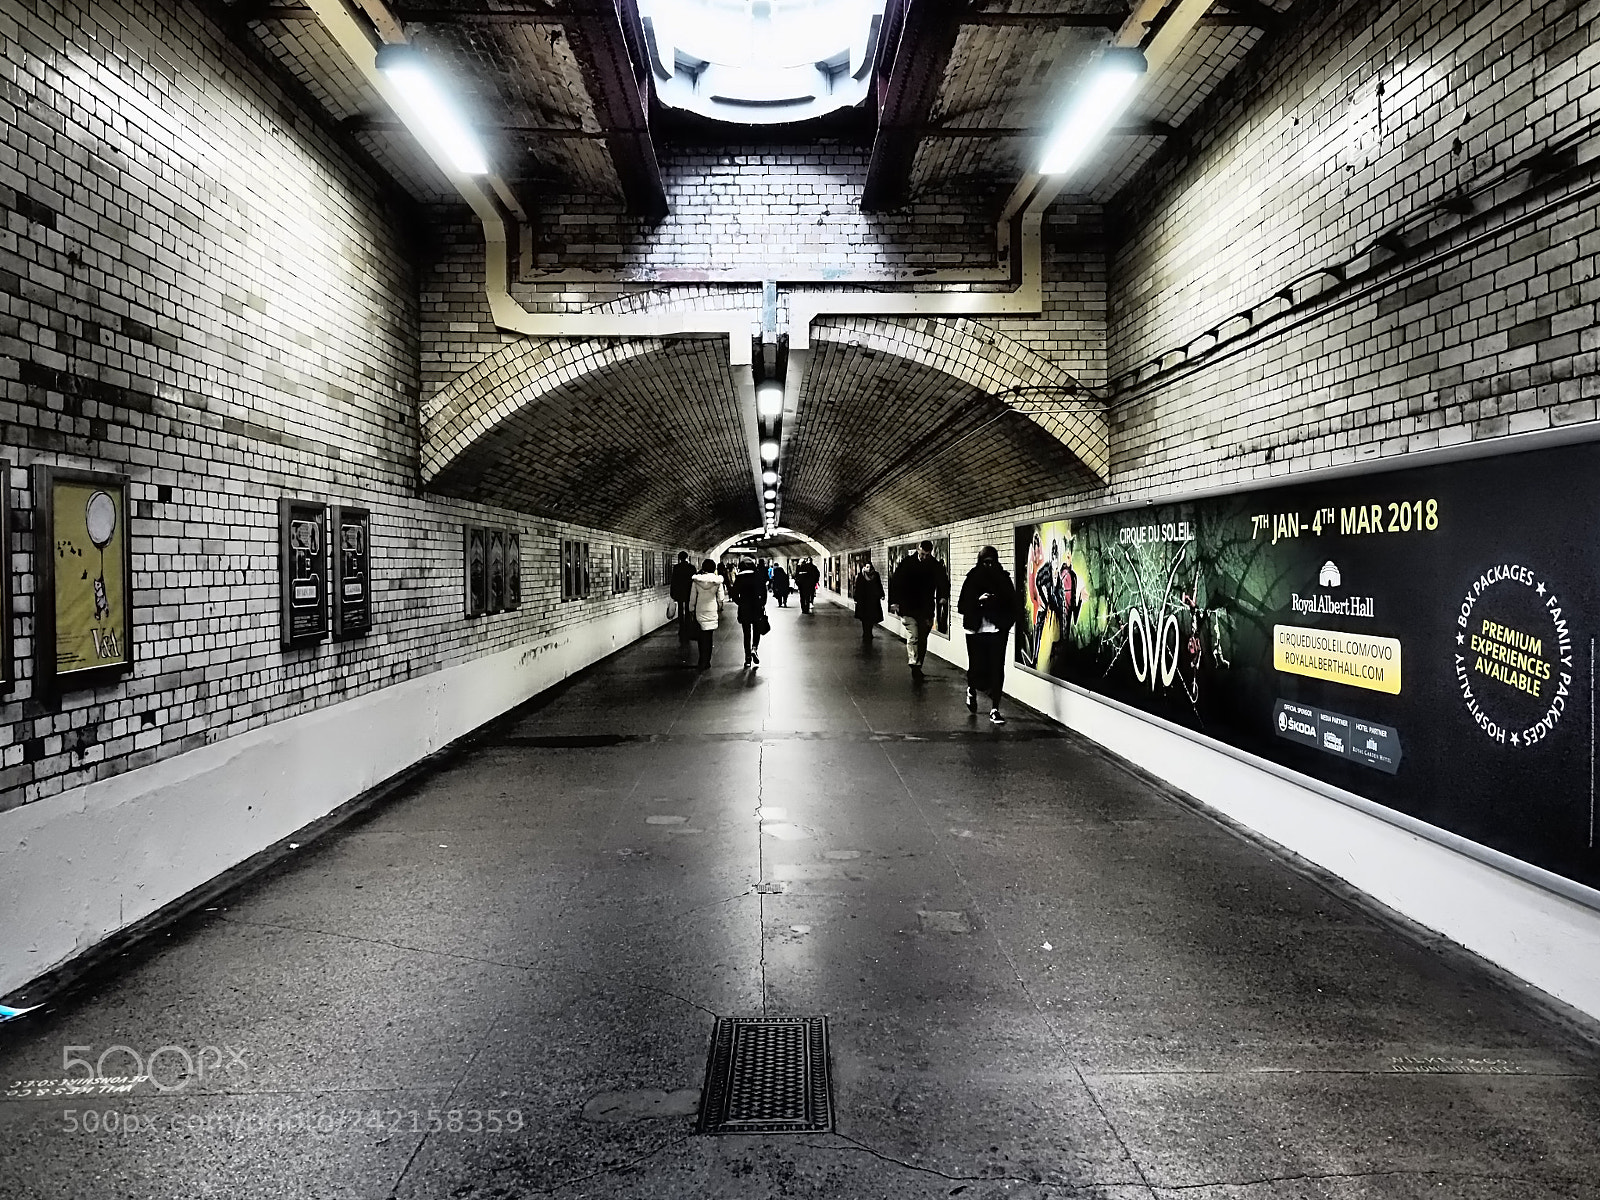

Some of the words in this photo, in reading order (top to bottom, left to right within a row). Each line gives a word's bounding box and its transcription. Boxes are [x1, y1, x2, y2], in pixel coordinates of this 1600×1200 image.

[1119, 526, 1147, 545] CIRQUE
[1148, 524, 1160, 542] DU
[1271, 512, 1299, 545] JAN
[1340, 504, 1384, 535] MAR
[1387, 498, 1439, 533] 2018
[1291, 593, 1317, 616] Royal
[1316, 594, 1350, 616] Albert
[1350, 596, 1375, 618] Hall
[1457, 590, 1477, 628] BOX
[1472, 564, 1535, 597] PACKAGES
[1128, 548, 1180, 692] OVO
[1481, 619, 1542, 657] PREMIUM
[1545, 595, 1573, 668] FAMILY
[1279, 632, 1393, 661] CIRQUEDUSOLEIL.COM/OVO
[1285, 651, 1384, 682] ROYALALBERTHALL.COM
[1470, 634, 1551, 680] EXPERIENCES
[1454, 653, 1506, 744] HOSPITALITY
[1474, 656, 1541, 698] AVAILABLE
[1287, 716, 1317, 738] ŠKODA
[1522, 672, 1572, 746] PACKAGES
